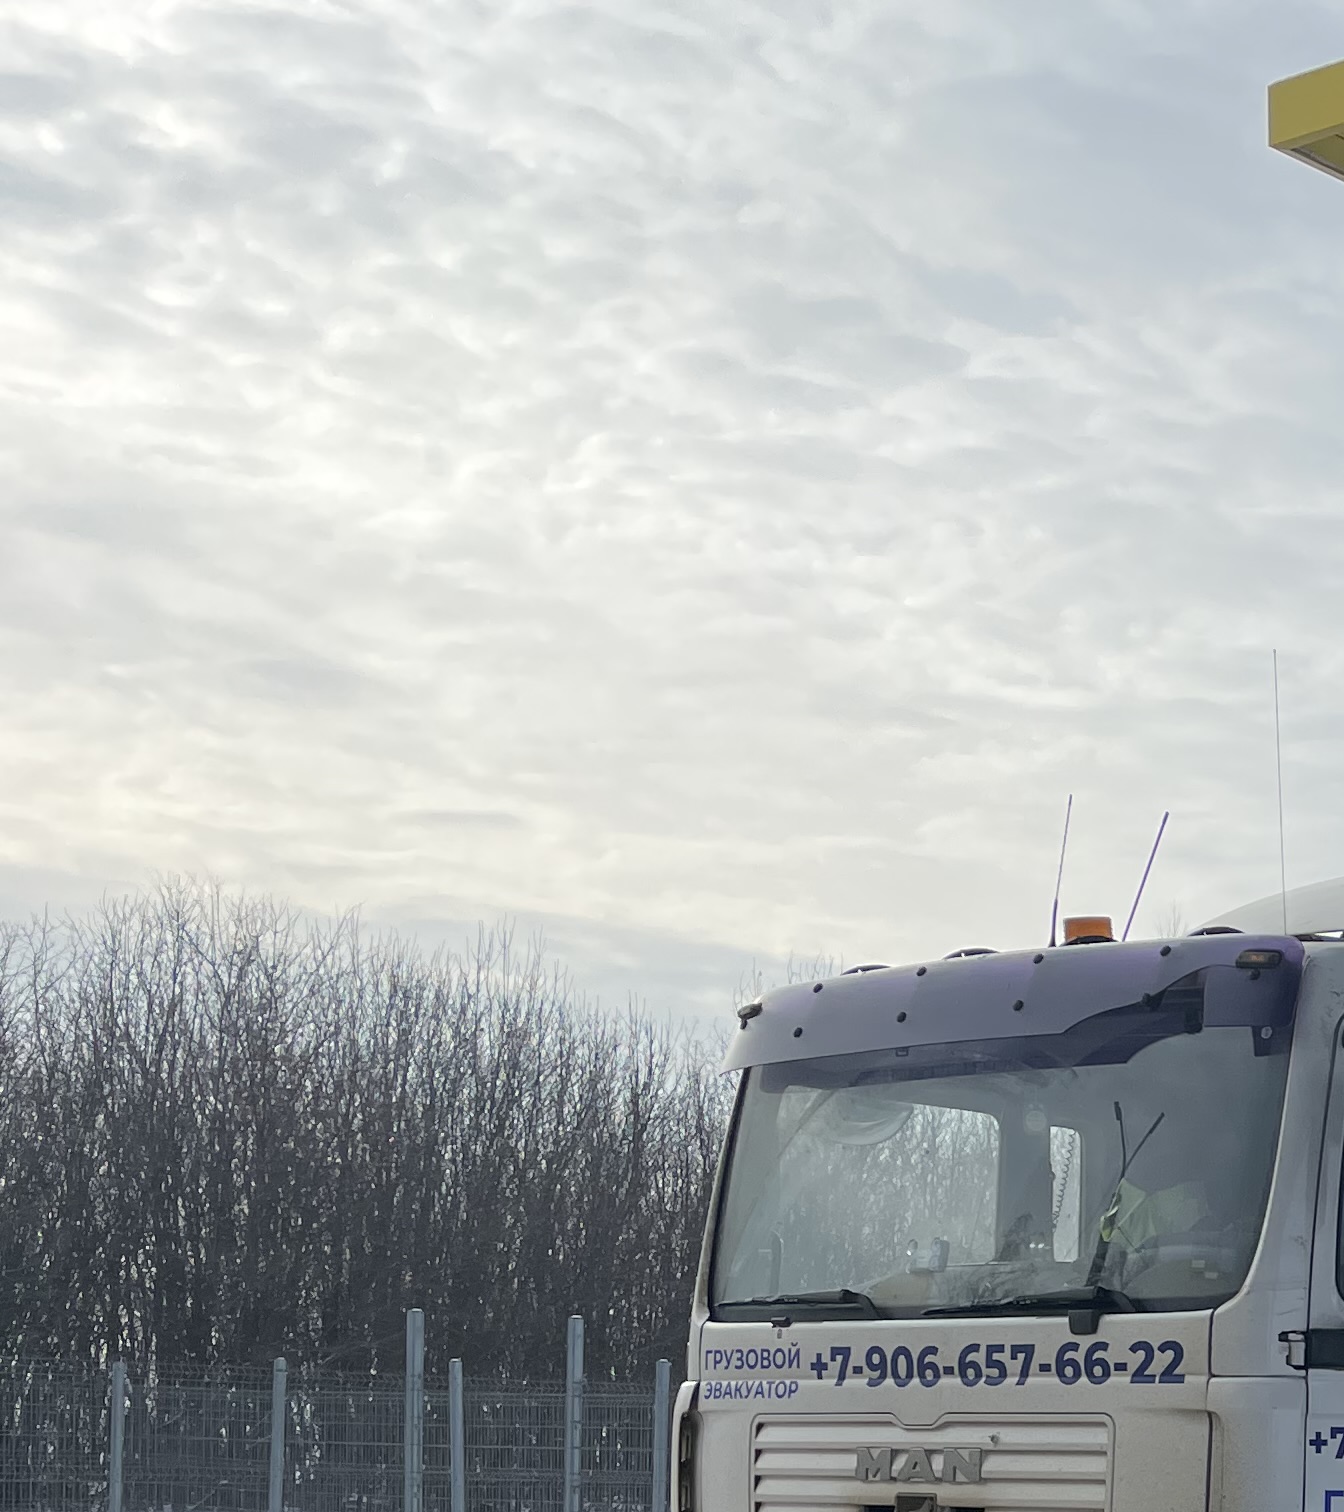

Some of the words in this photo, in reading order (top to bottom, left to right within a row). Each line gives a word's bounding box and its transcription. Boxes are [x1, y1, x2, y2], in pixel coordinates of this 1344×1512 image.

[705, 1342, 801, 1371] ГРУЗОВОЙ
[810, 1340, 1186, 1388] +7-906-657-66-22
[704, 1380, 799, 1400] ЭВАКУАТОР
[855, 1446, 983, 1484] MAN
